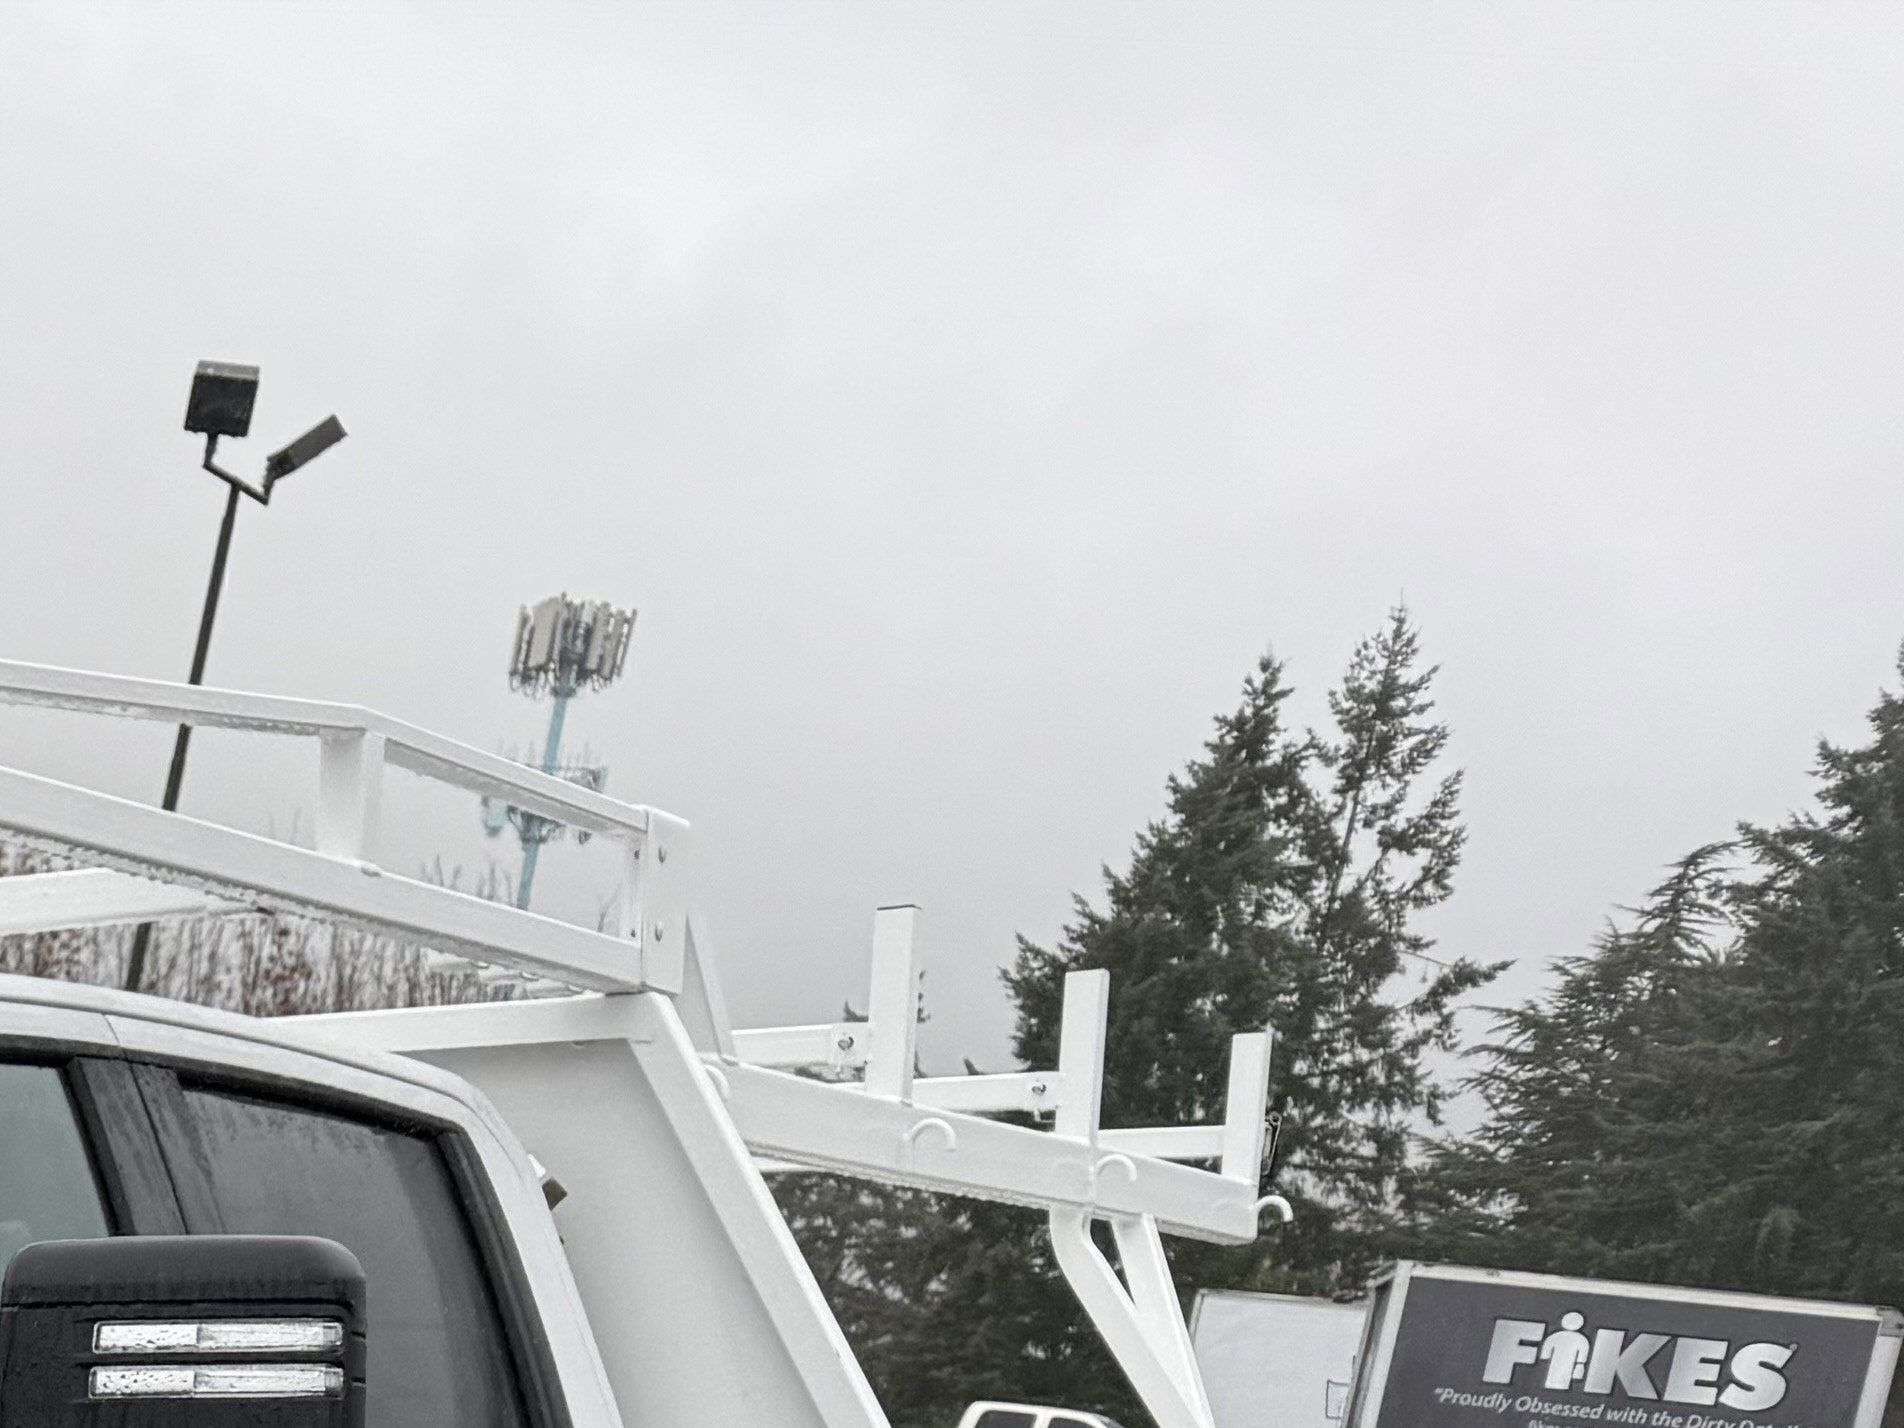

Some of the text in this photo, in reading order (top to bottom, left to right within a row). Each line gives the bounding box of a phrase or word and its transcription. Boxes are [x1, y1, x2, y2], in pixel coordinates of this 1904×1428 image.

[1515, 1395, 1605, 1420] Obsessed
[1606, 1406, 1647, 1424] with
[1651, 1410, 1683, 1428] the
